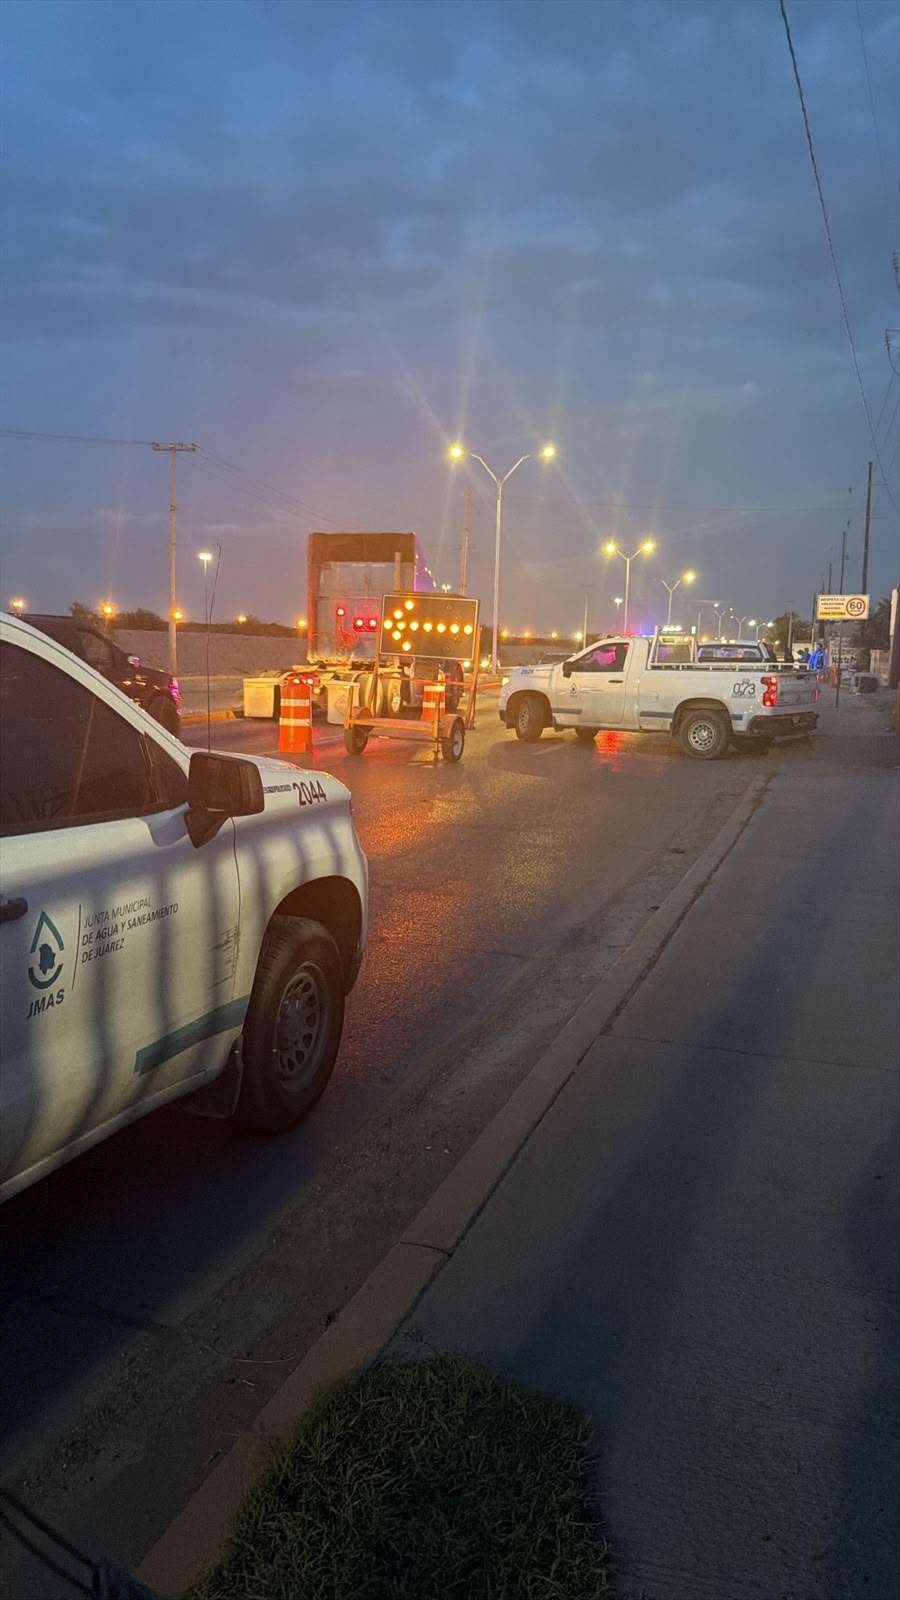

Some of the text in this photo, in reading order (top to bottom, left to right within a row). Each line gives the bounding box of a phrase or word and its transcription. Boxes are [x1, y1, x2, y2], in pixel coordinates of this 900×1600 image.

[849, 602, 862, 610] 60
[293, 780, 327, 806] 2044
[82, 903, 179, 946] DE AGUA Y SANEAMIENTO
[84, 897, 151, 928] JUNTA MUNICIPAL
[82, 937, 125, 963] DE JUÁREZ
[27, 989, 65, 1019] JMAS
